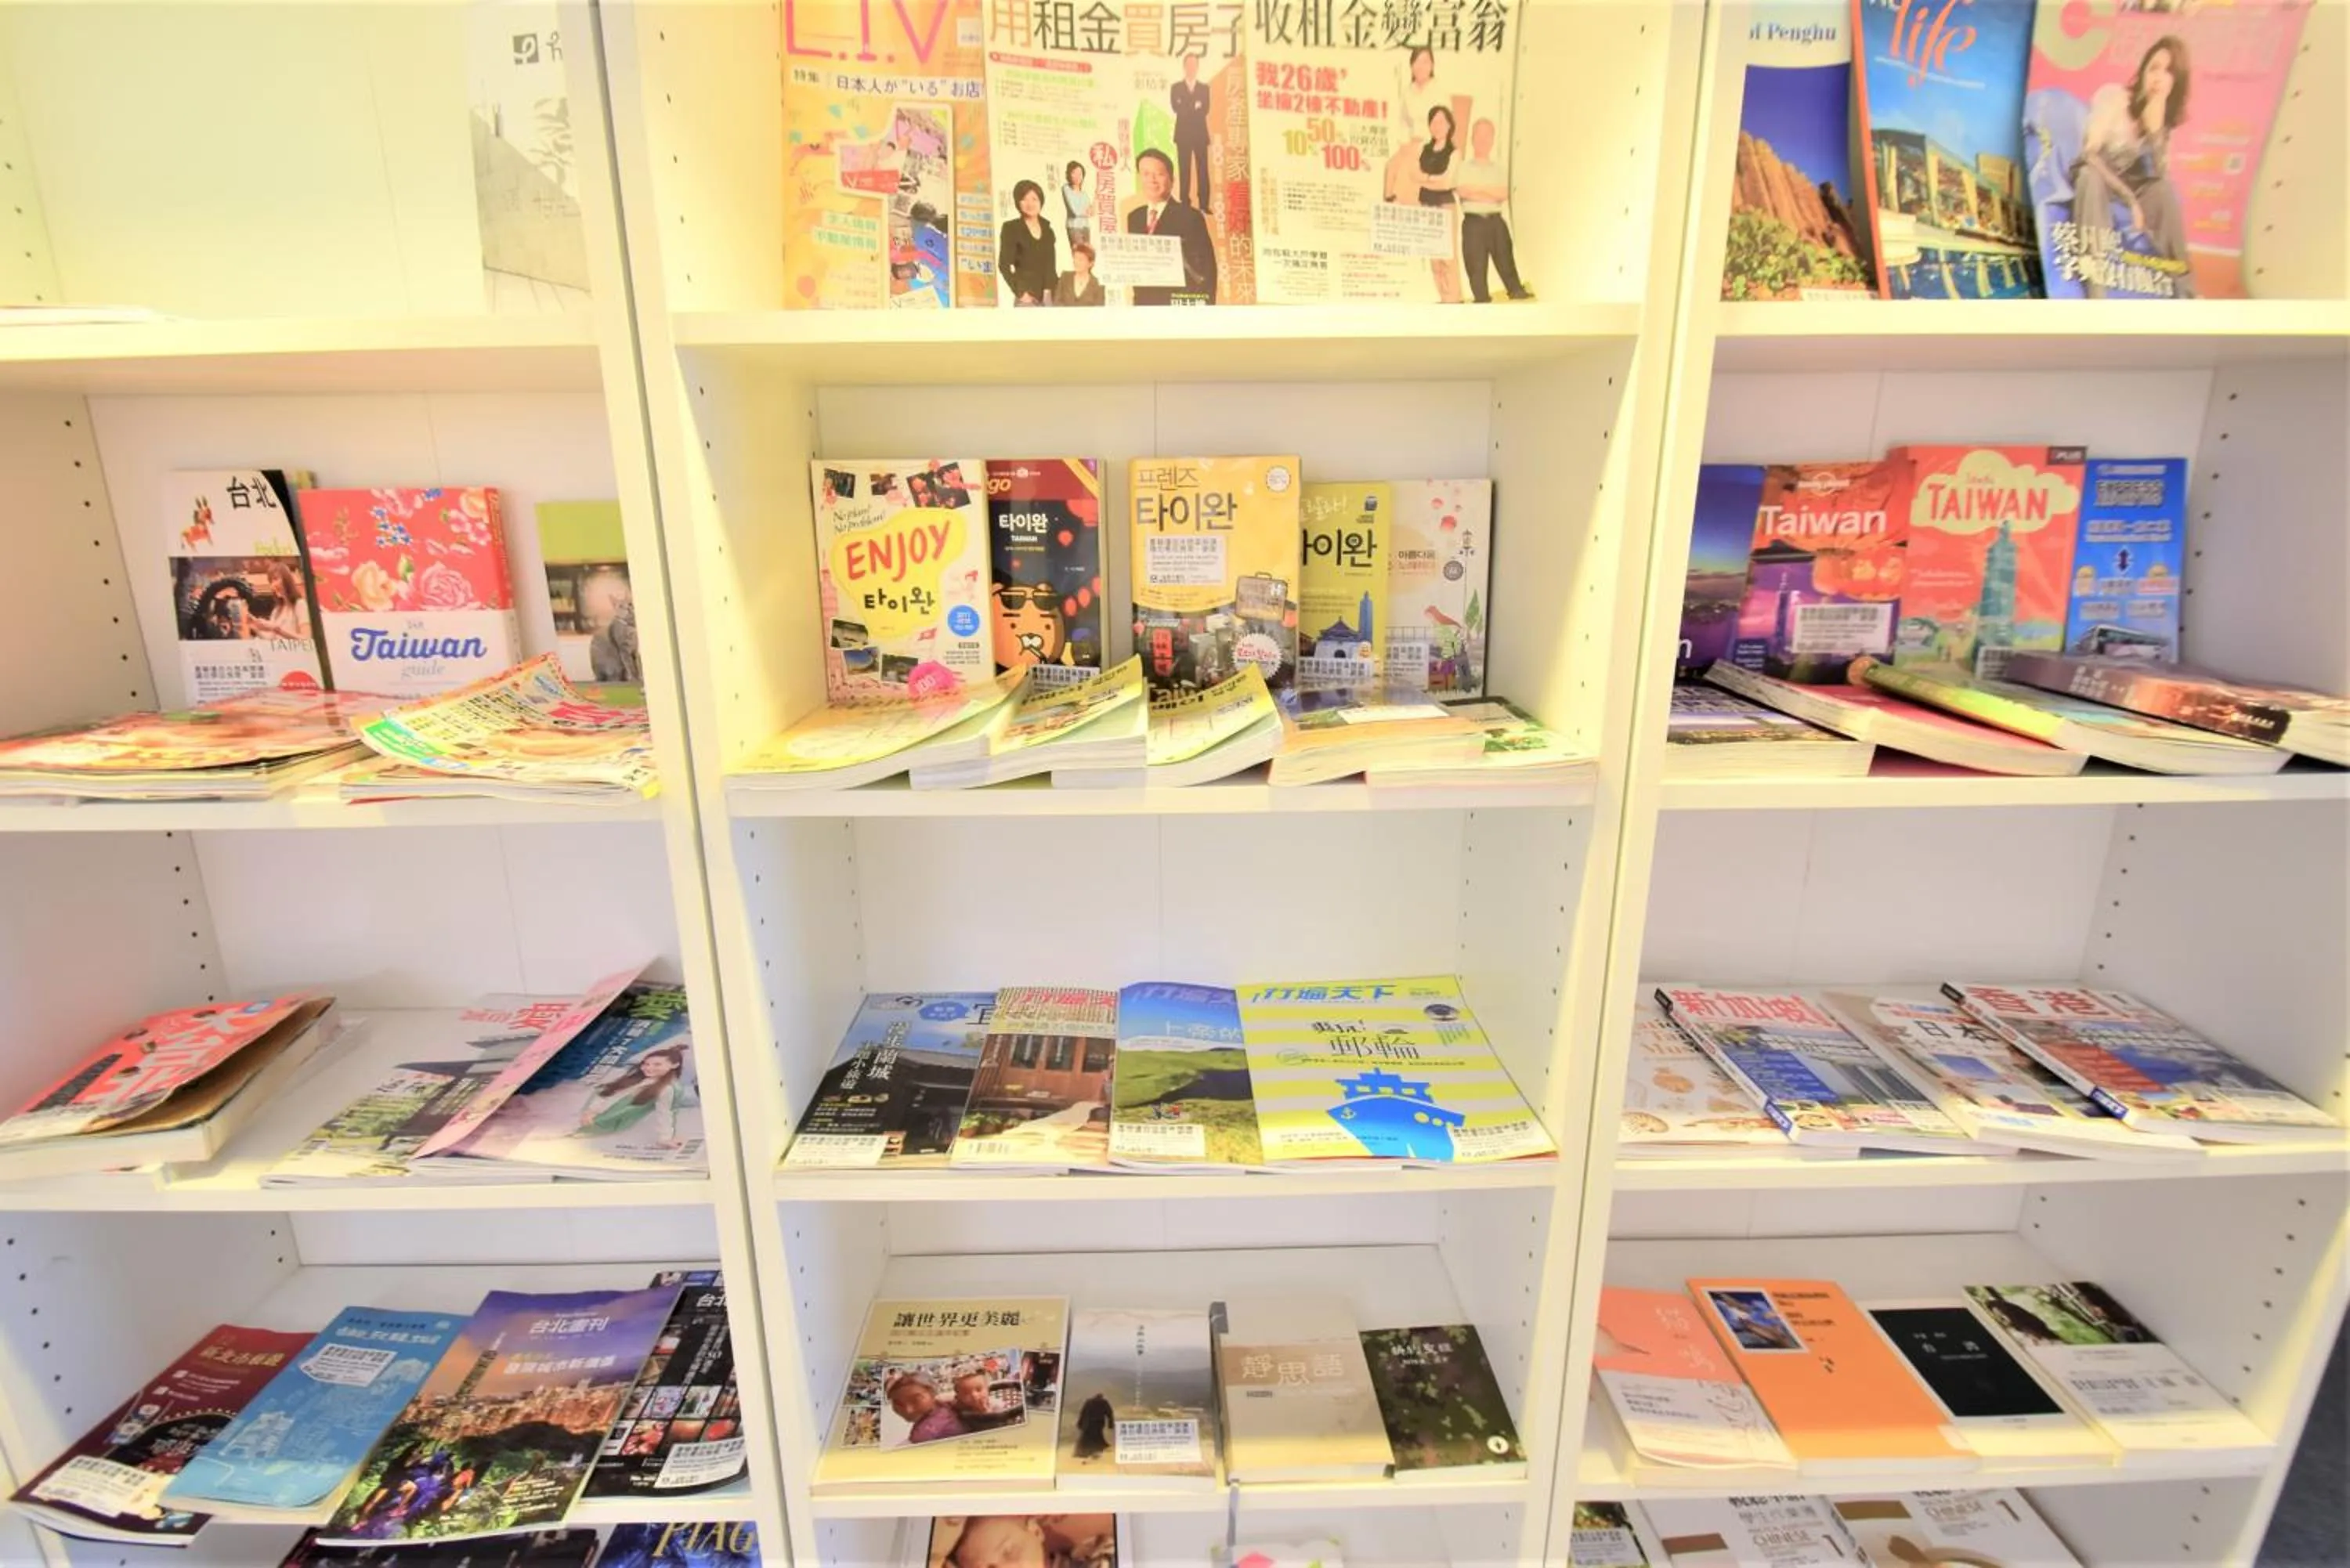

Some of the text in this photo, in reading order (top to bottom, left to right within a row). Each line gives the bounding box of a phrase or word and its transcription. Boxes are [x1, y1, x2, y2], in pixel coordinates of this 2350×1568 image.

[1255, 0, 1510, 52] 收租金變富翁
[1768, 22, 1836, 44] Penghu
[226, 475, 277, 509] 台北
[989, 477, 1011, 495] go
[1137, 466, 1200, 491] 프렌즈
[1136, 492, 1238, 532] 타이완
[1928, 483, 2049, 521] TAIWAN
[999, 513, 1049, 533] 타이완
[1759, 505, 1886, 536] Taiwan
[845, 520, 951, 582] ENJOY
[864, 587, 935, 615] 타이완
[350, 628, 487, 661] Taiwan
[400, 661, 446, 678] guide
[1669, 988, 1836, 1028] 新加坡
[1914, 1019, 1999, 1042] 日本
[893, 1311, 1021, 1328] 讓世界更美麗
[1242, 1353, 1343, 1387] 靜思語
